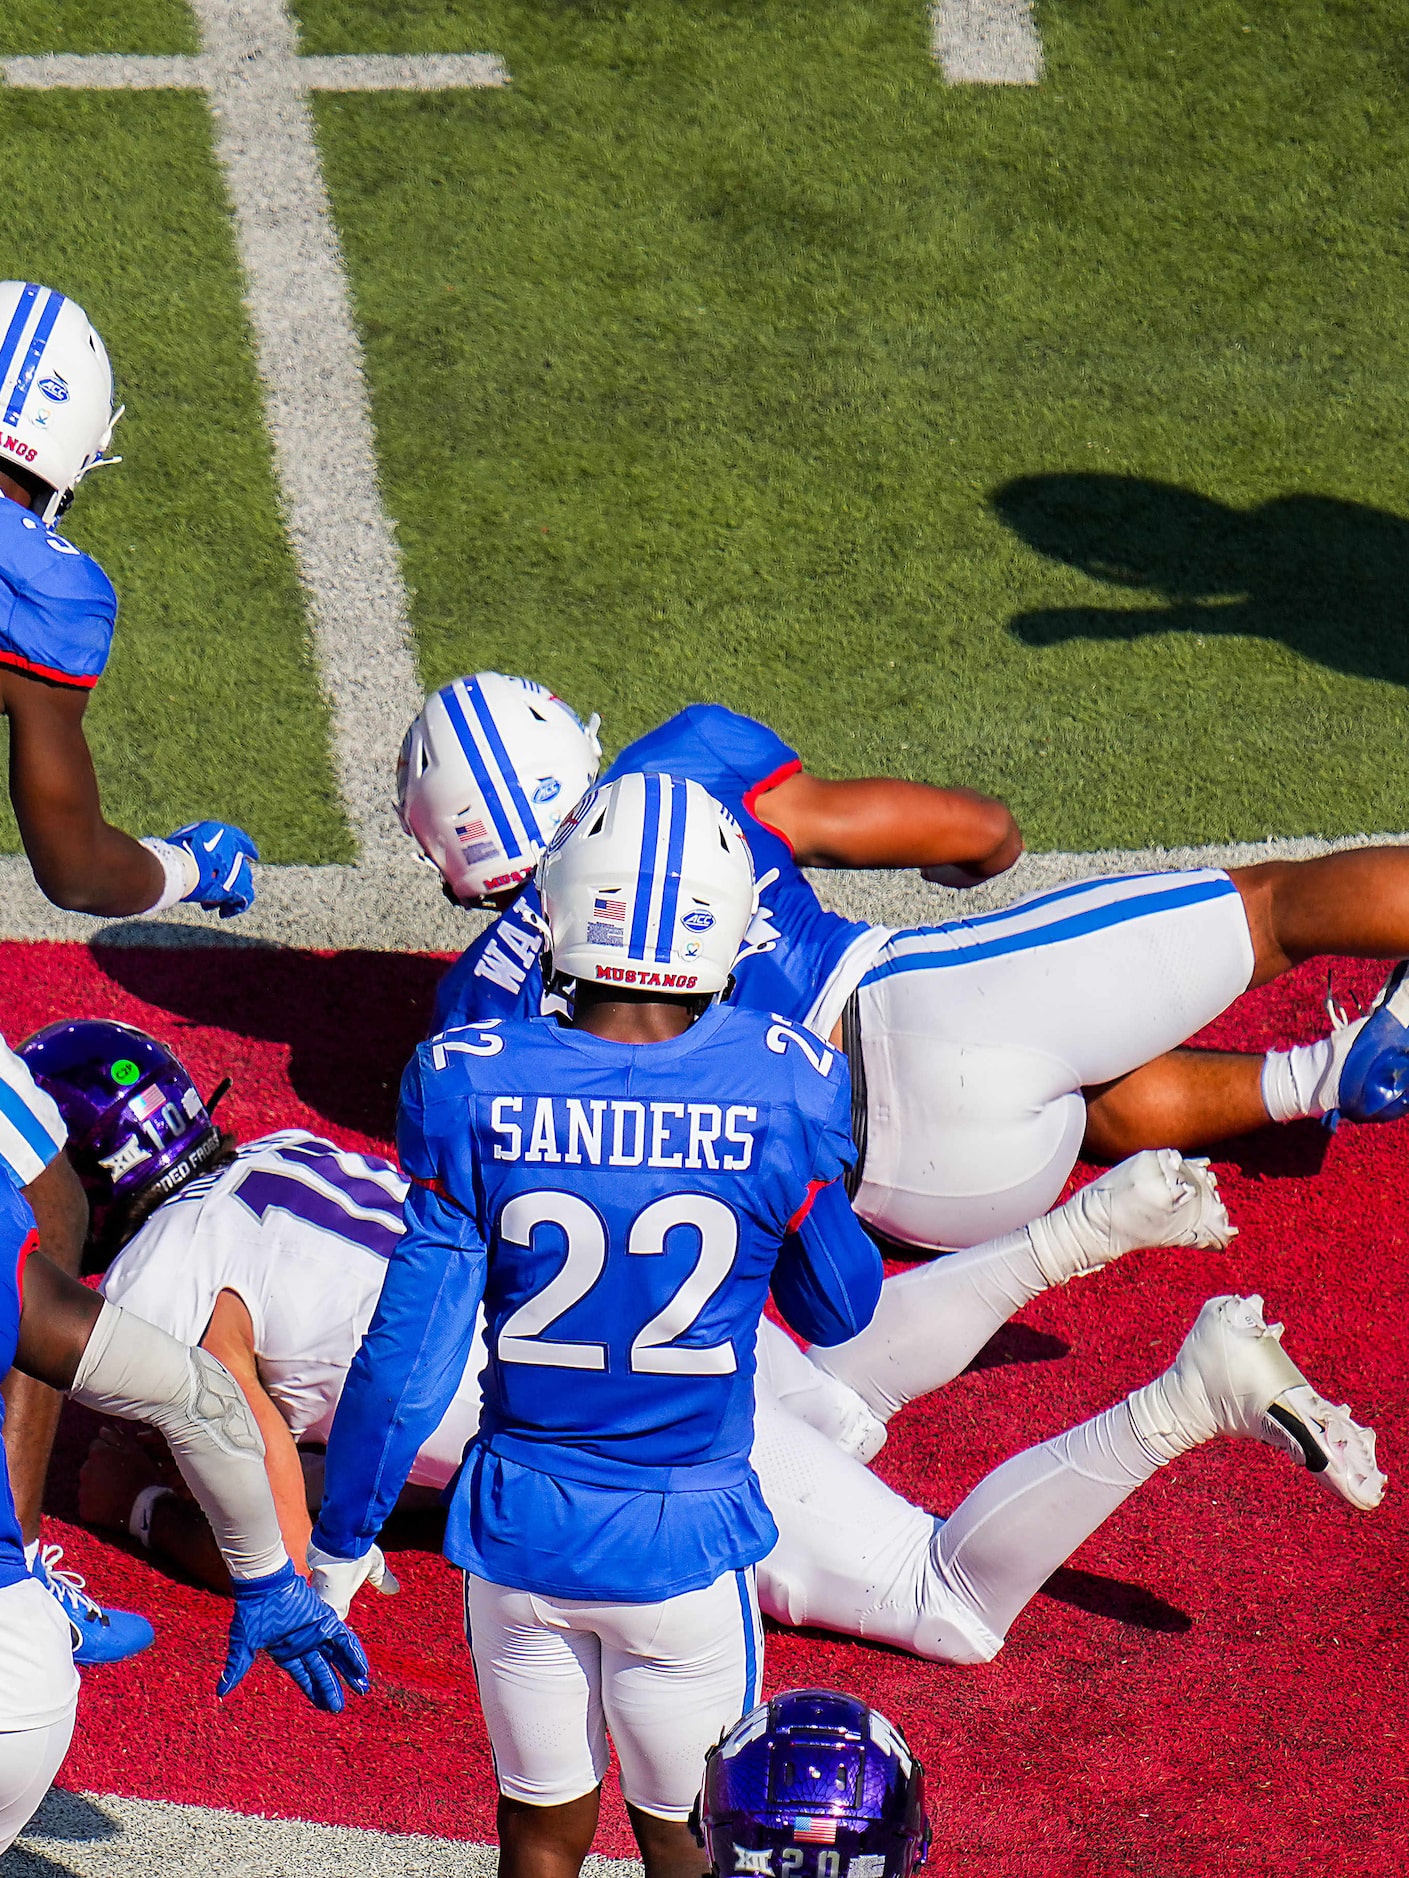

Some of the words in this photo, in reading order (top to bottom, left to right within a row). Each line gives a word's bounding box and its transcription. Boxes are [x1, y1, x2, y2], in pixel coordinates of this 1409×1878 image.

[40, 380, 69, 401] ACC
[685, 914, 713, 928] ACC
[595, 964, 698, 989] MUSTANGS
[141, 1102, 186, 1152] 10
[492, 1097, 758, 1170] SANDERS
[498, 1190, 739, 1375] 22
